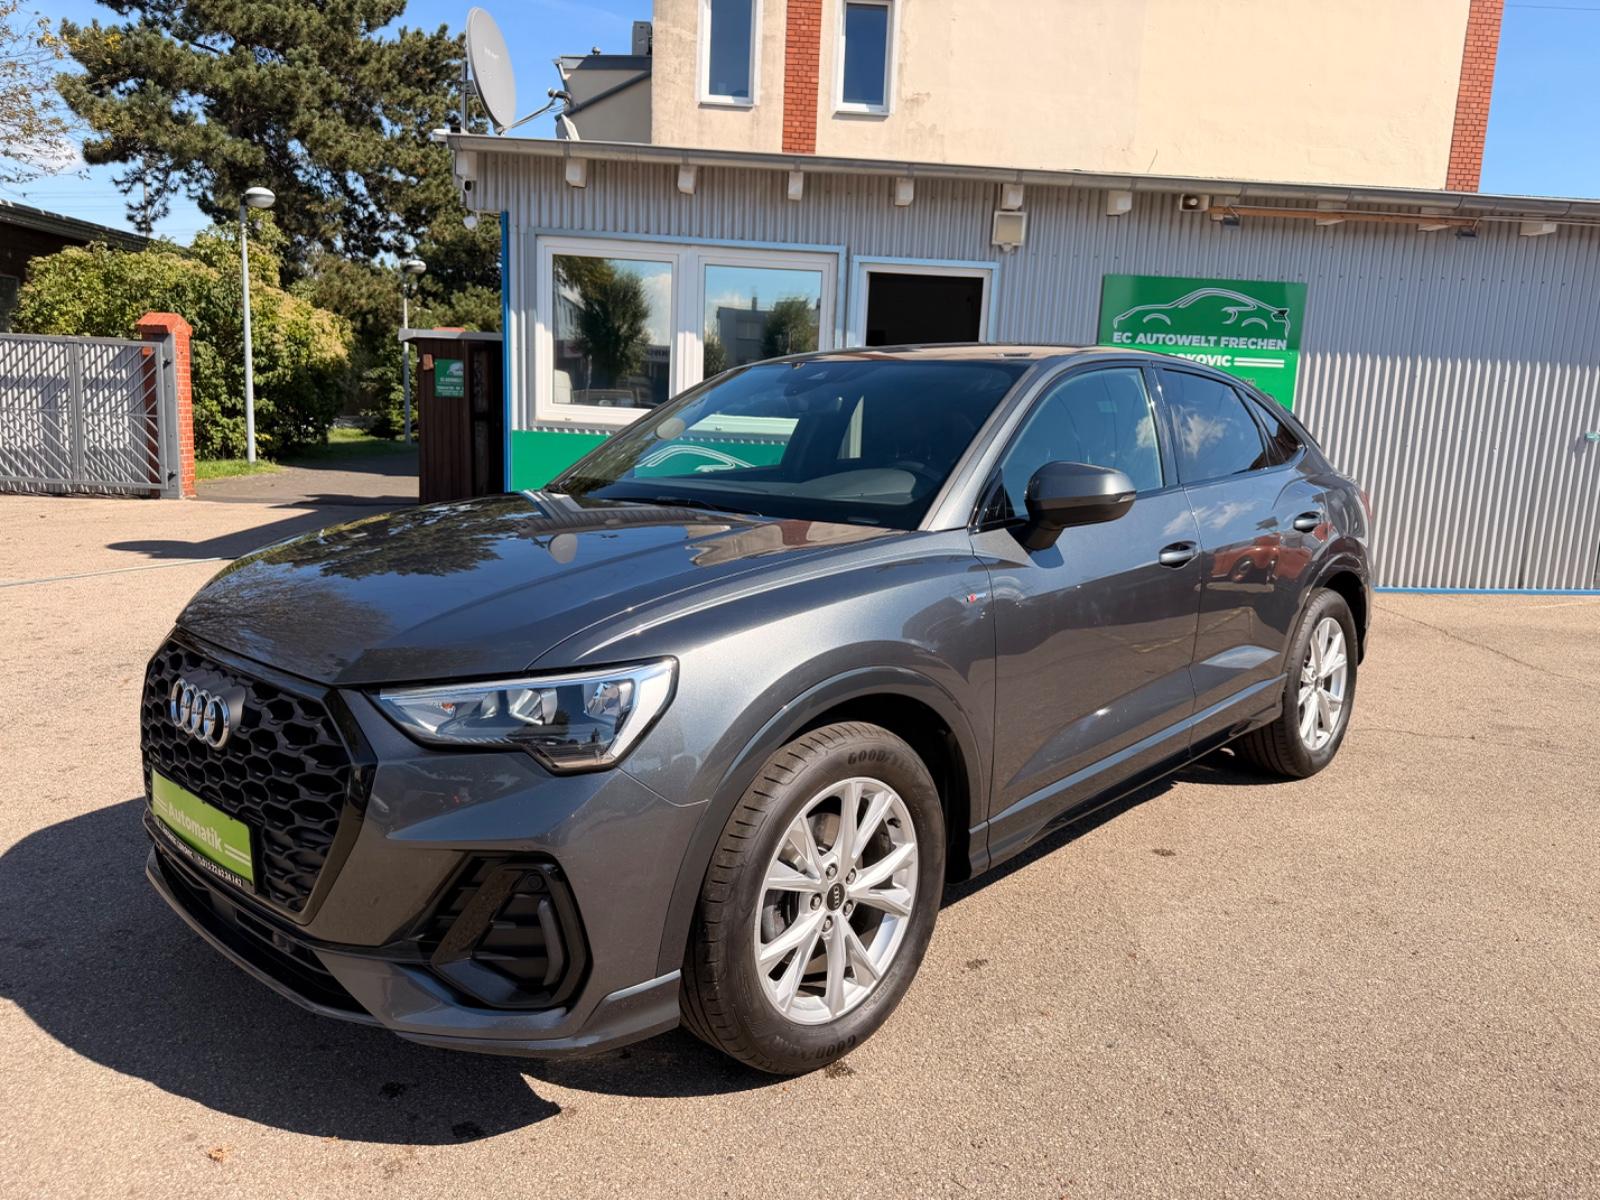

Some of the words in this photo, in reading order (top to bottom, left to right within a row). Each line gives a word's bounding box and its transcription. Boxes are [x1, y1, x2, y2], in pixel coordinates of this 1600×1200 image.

[1112, 332, 1133, 344] EC
[1135, 333, 1217, 348] AUTOWELT
[1220, 336, 1288, 351] FRECHEN
[168, 802, 223, 853] Automatik
